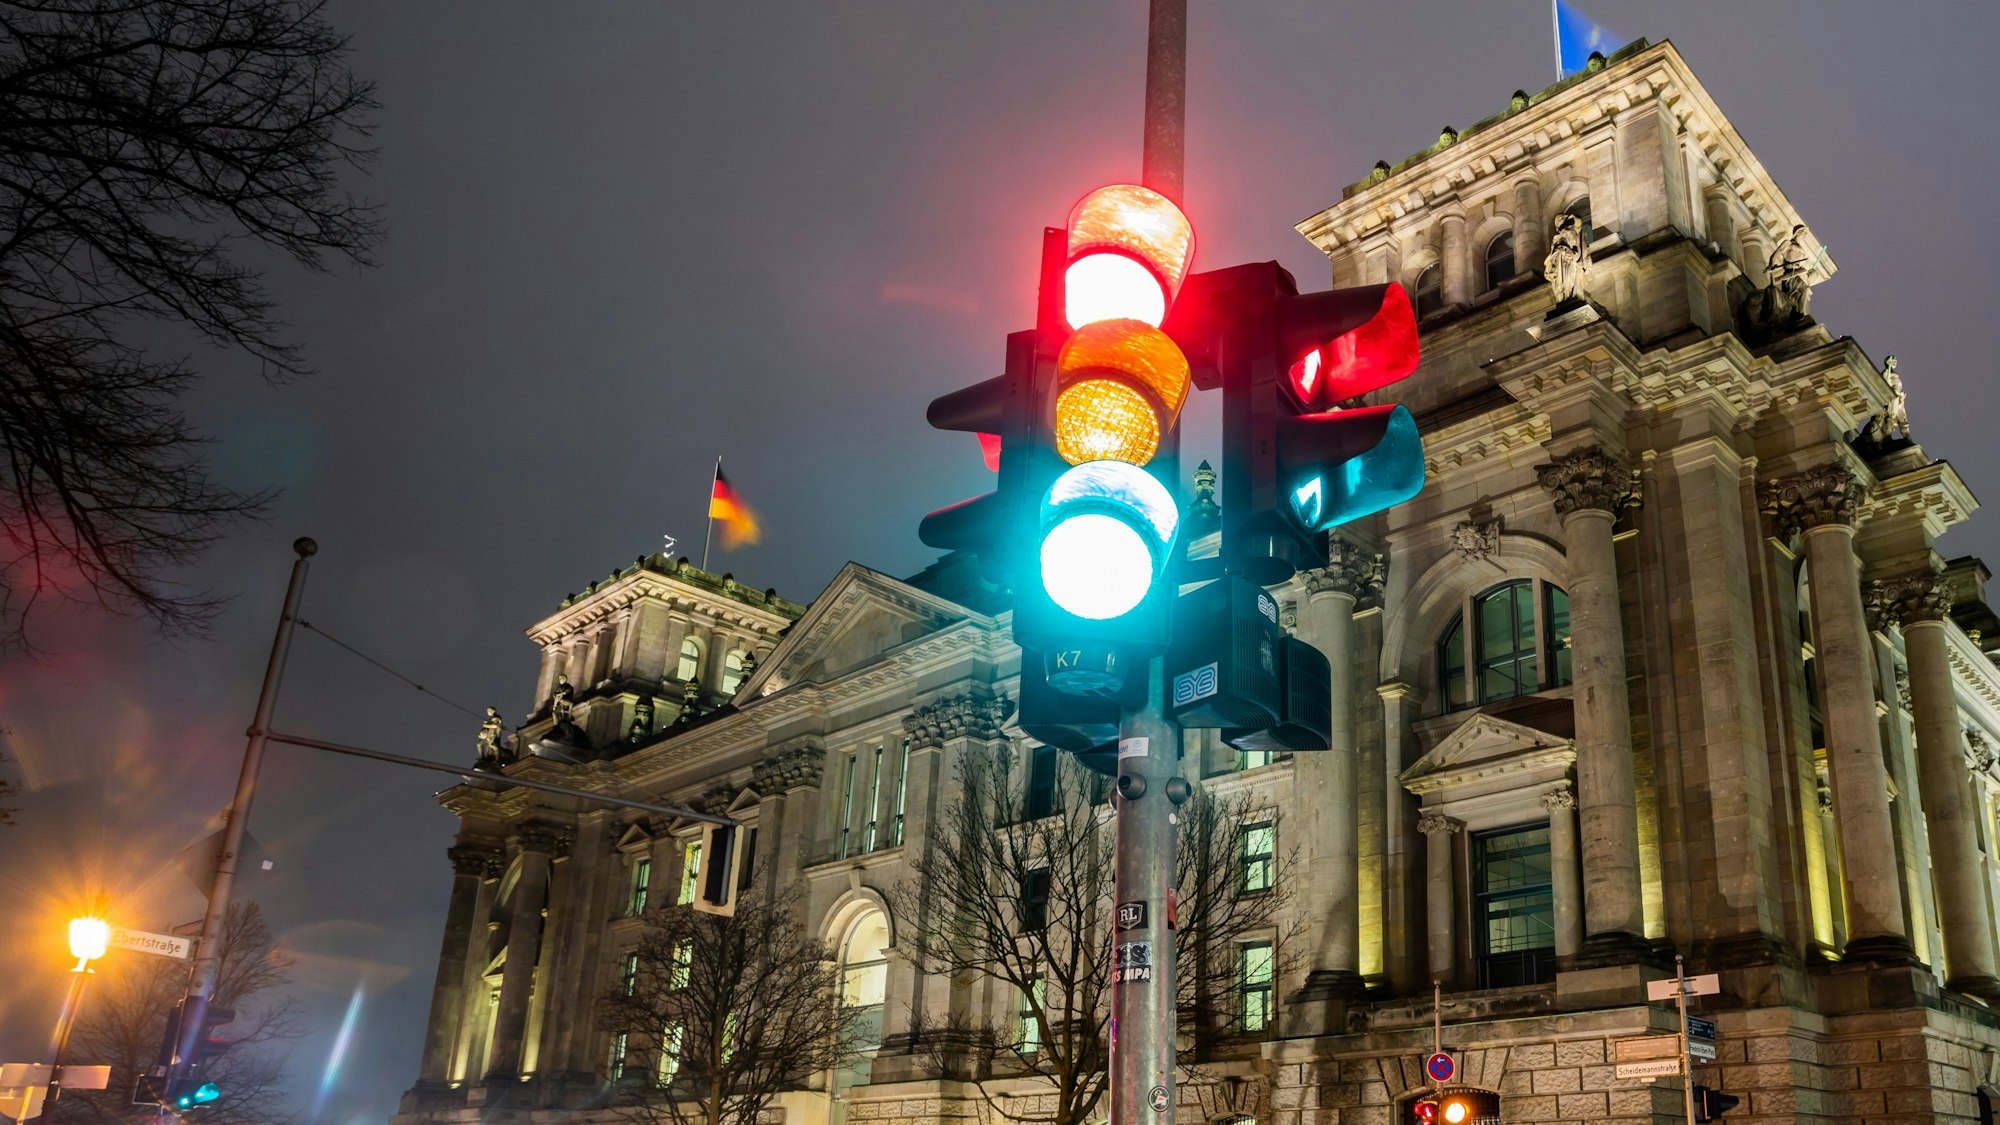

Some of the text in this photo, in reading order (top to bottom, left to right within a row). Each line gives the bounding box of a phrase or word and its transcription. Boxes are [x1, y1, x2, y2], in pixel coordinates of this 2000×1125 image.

[1056, 650, 1081, 668] K7
[1120, 908, 1138, 921] RL
[113, 930, 181, 954] Ebertstraße
[1618, 1064, 1677, 1075] Scheidemannstraße
